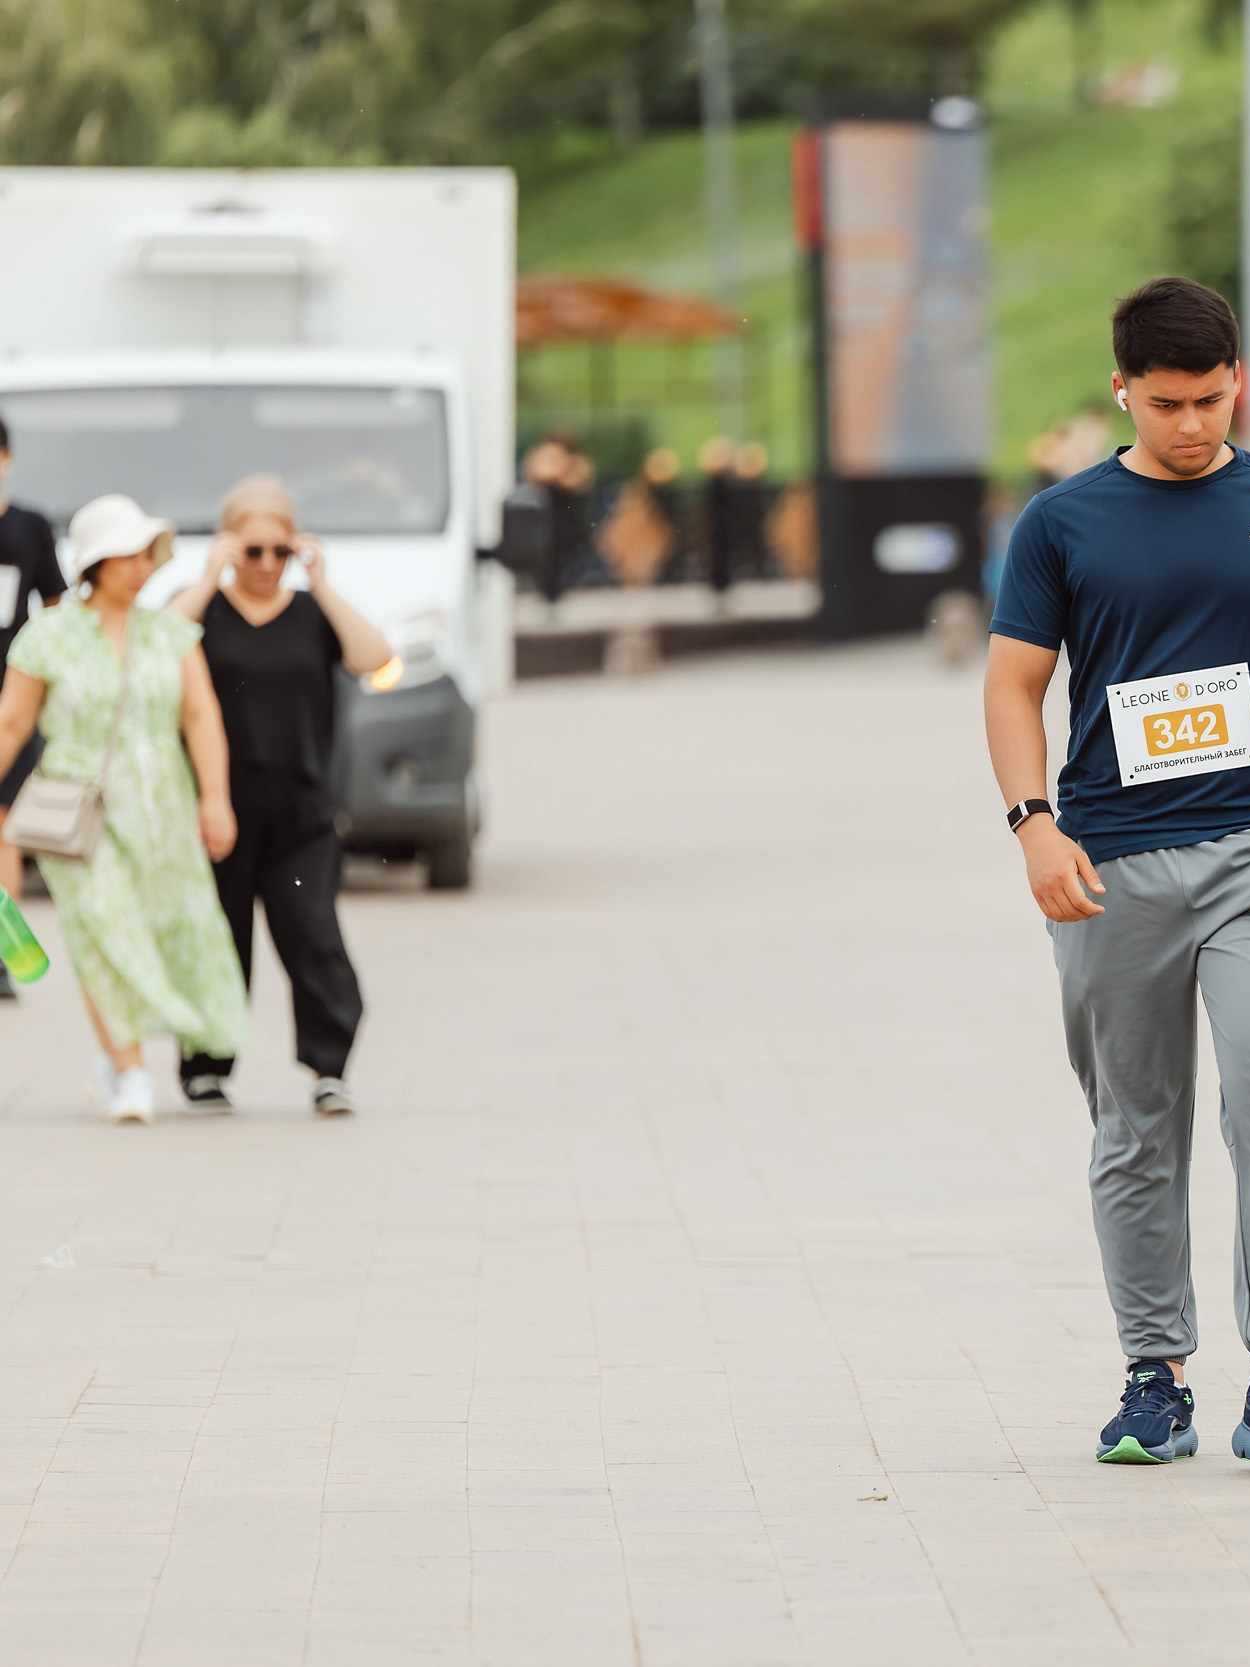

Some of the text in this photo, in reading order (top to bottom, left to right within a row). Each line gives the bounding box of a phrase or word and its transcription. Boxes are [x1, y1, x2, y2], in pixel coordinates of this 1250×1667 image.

[1121, 679, 1238, 708] LEONE D'ORO
[1152, 711, 1220, 749] 342
[1134, 747, 1247, 773] БЛАГОТВОРИТЕЛЬНЫЙ ЗАБЕГ
